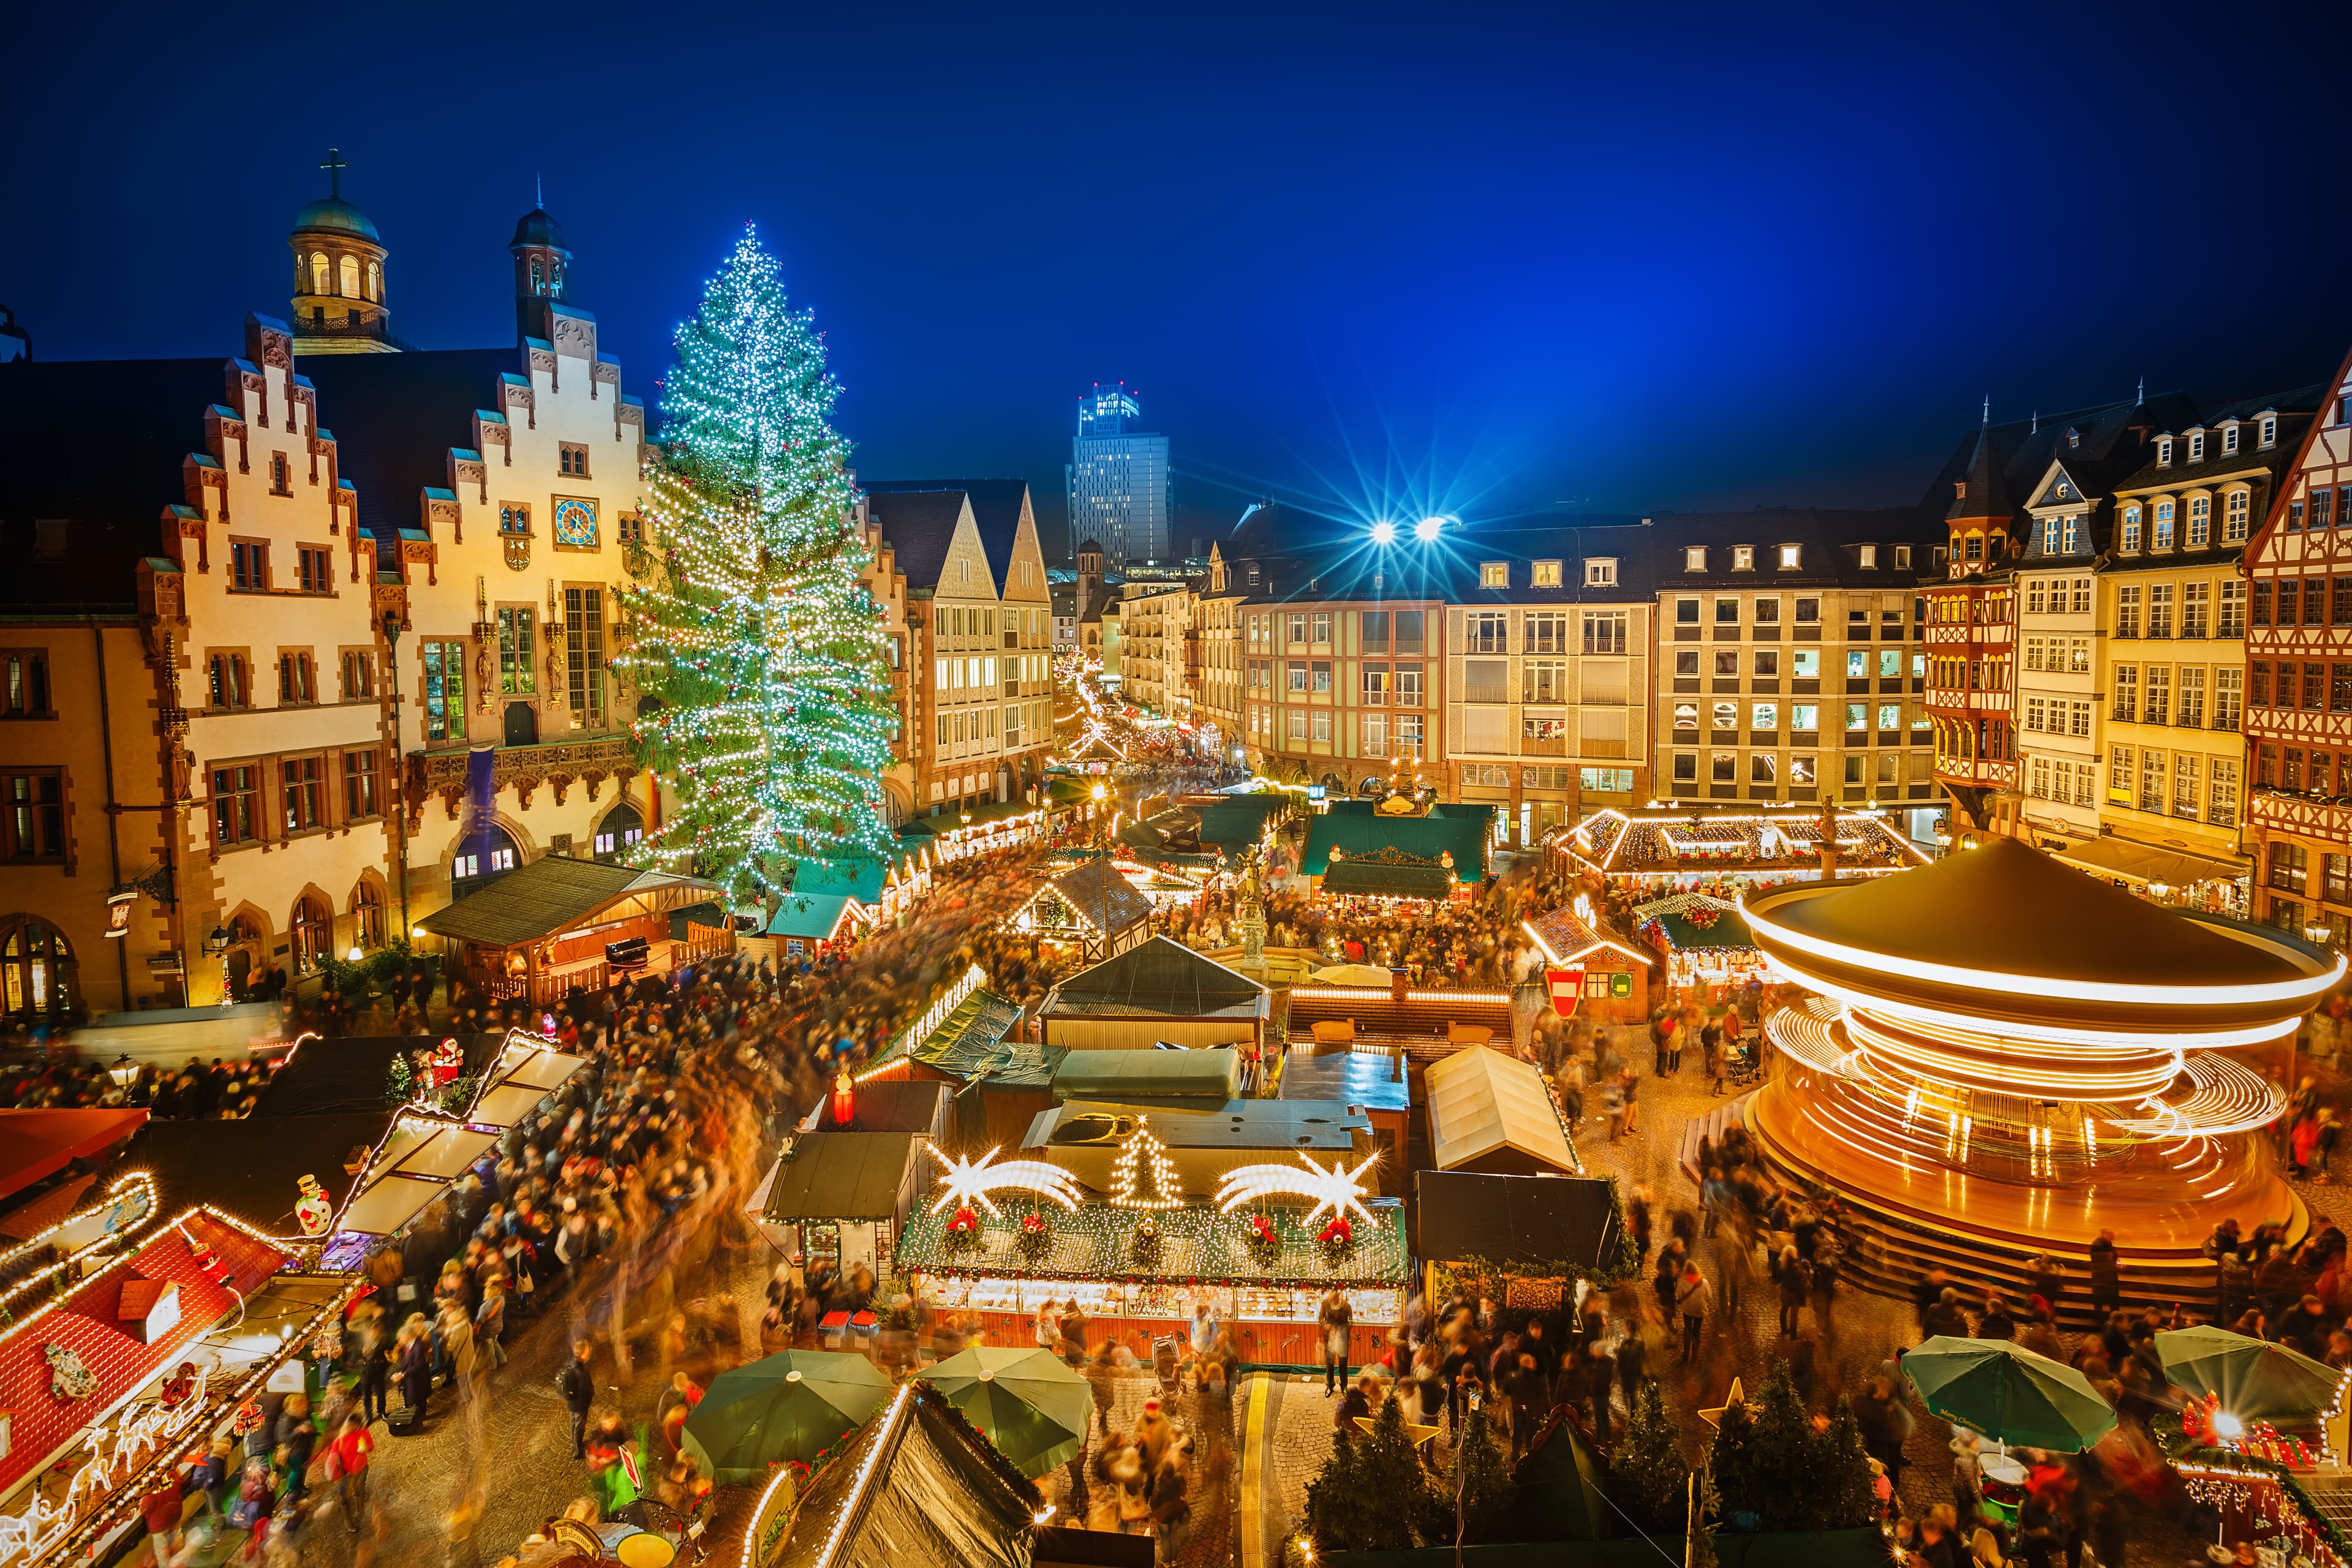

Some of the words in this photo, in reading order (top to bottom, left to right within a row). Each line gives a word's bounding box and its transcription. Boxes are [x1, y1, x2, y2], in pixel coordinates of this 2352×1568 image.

[1940, 1409, 1958, 1422] Merry
[1958, 1417, 1987, 1433] Christmas
[559, 1528, 590, 1549] Welcome
